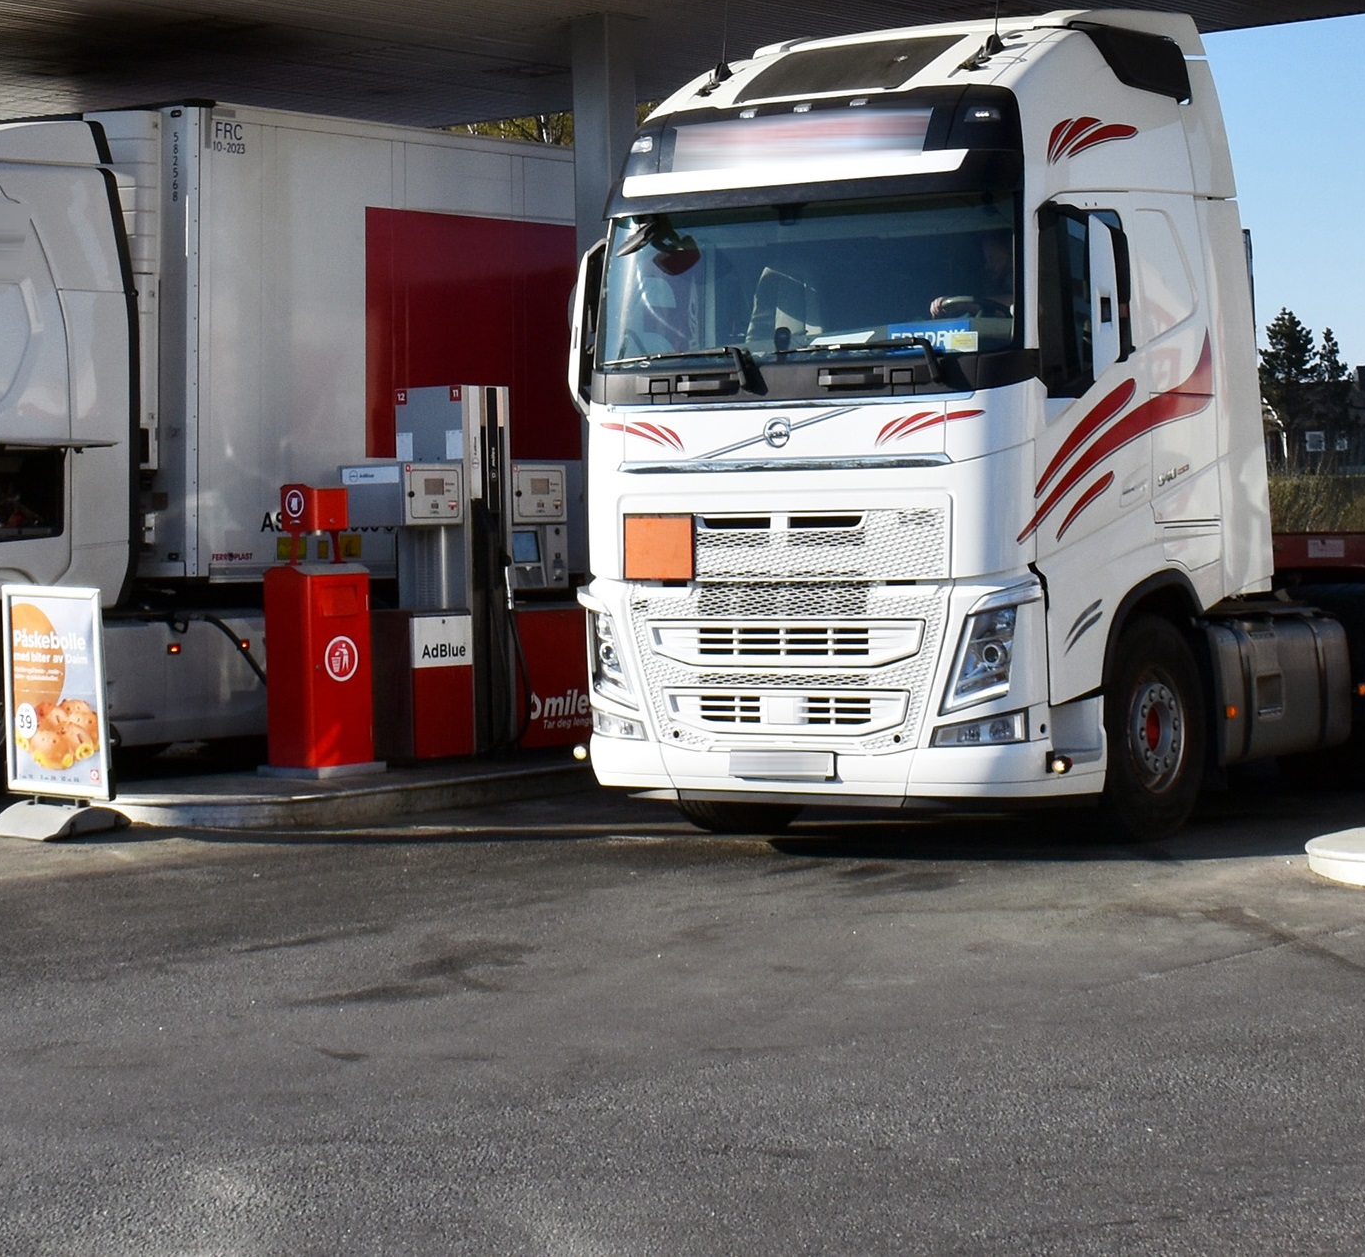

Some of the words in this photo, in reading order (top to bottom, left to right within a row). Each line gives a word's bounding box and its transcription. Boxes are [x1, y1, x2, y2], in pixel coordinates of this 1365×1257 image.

[215, 122, 243, 141] FRC
[212, 141, 246, 154] 10-2023
[397, 393, 406, 401] 12
[452, 389, 459, 398] 11
[13, 628, 86, 651] Påskebolle
[422, 643, 466, 659] AdBlue
[52, 653, 64, 664] av
[543, 719, 557, 730] Tar
[557, 718, 572, 729] deg
